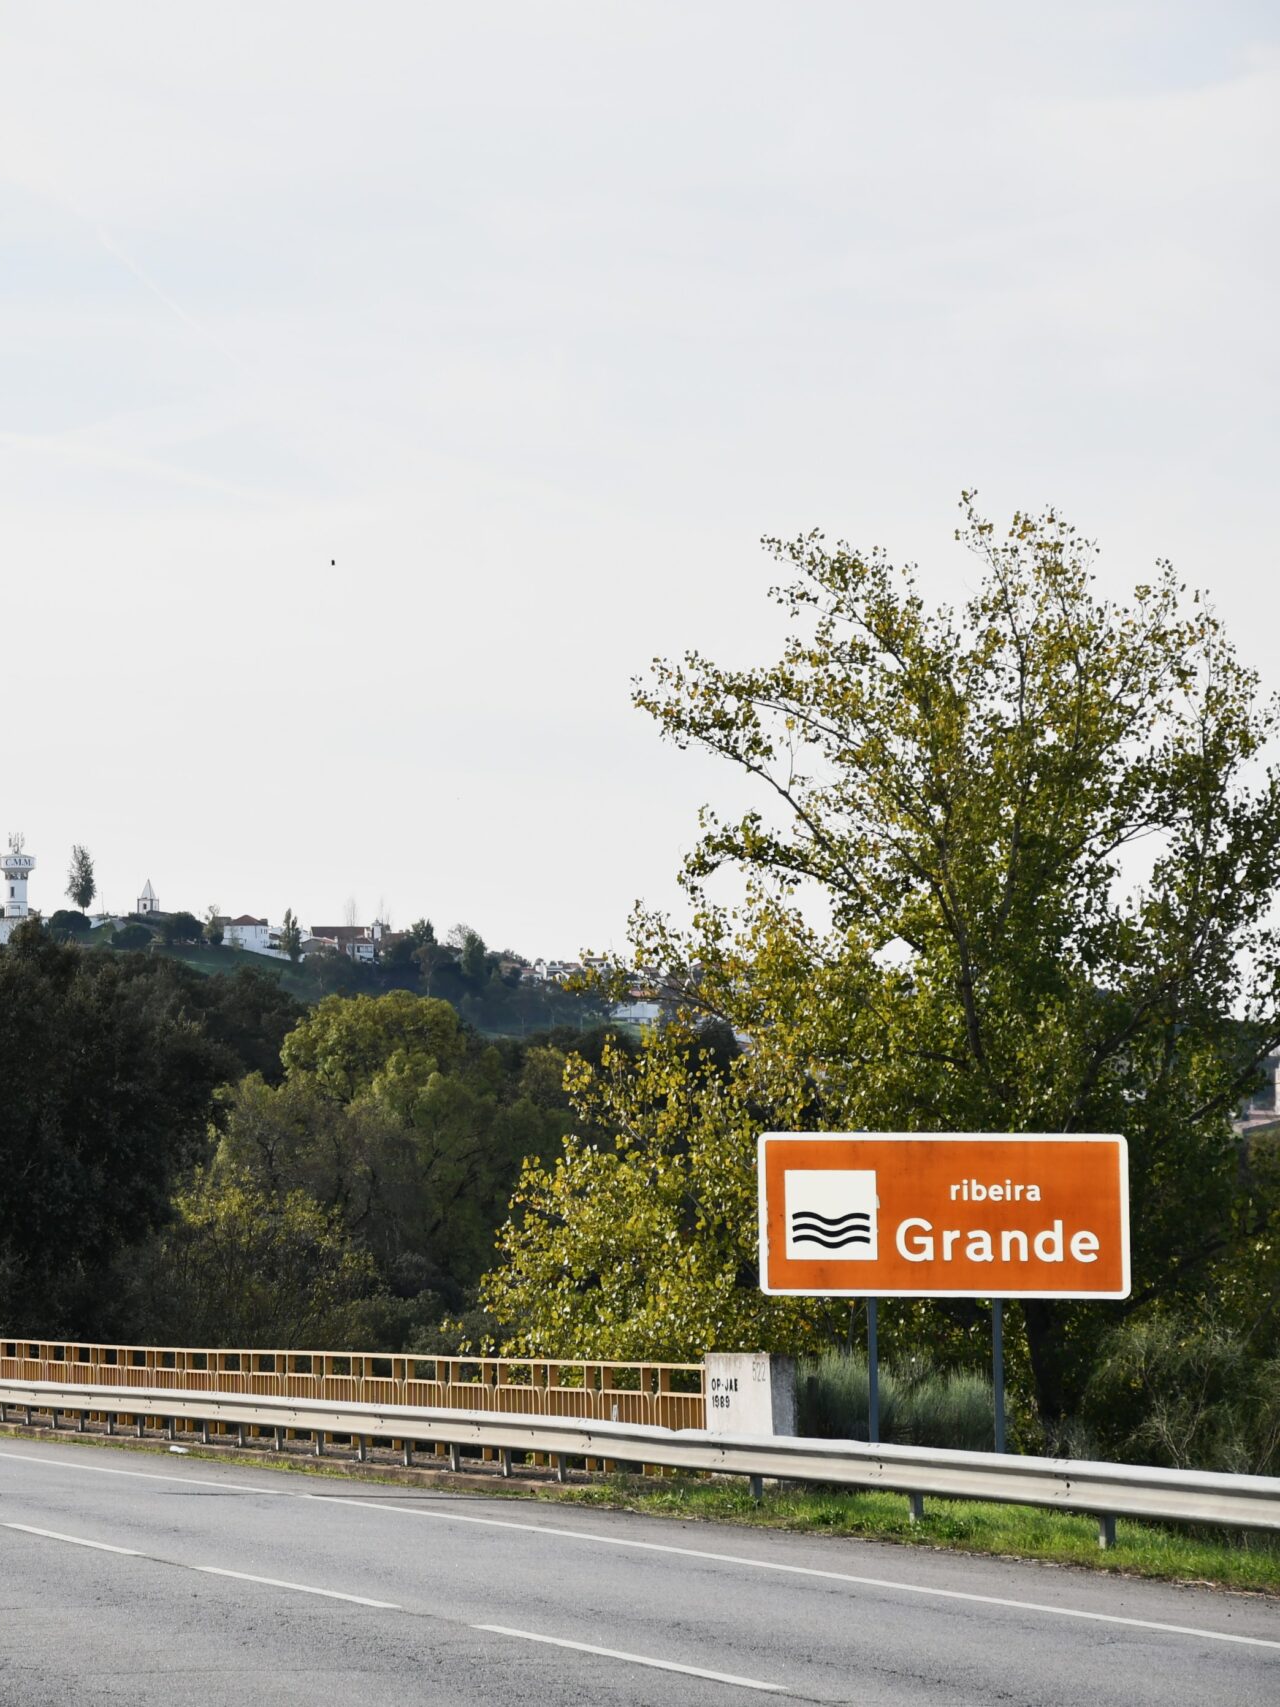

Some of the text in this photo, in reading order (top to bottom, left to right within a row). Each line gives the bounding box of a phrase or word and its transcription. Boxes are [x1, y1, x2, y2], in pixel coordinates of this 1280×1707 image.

[949, 1179, 1042, 1202] ribeira
[895, 1217, 1100, 1263] Grande
[711, 1395, 730, 1408] 1989
